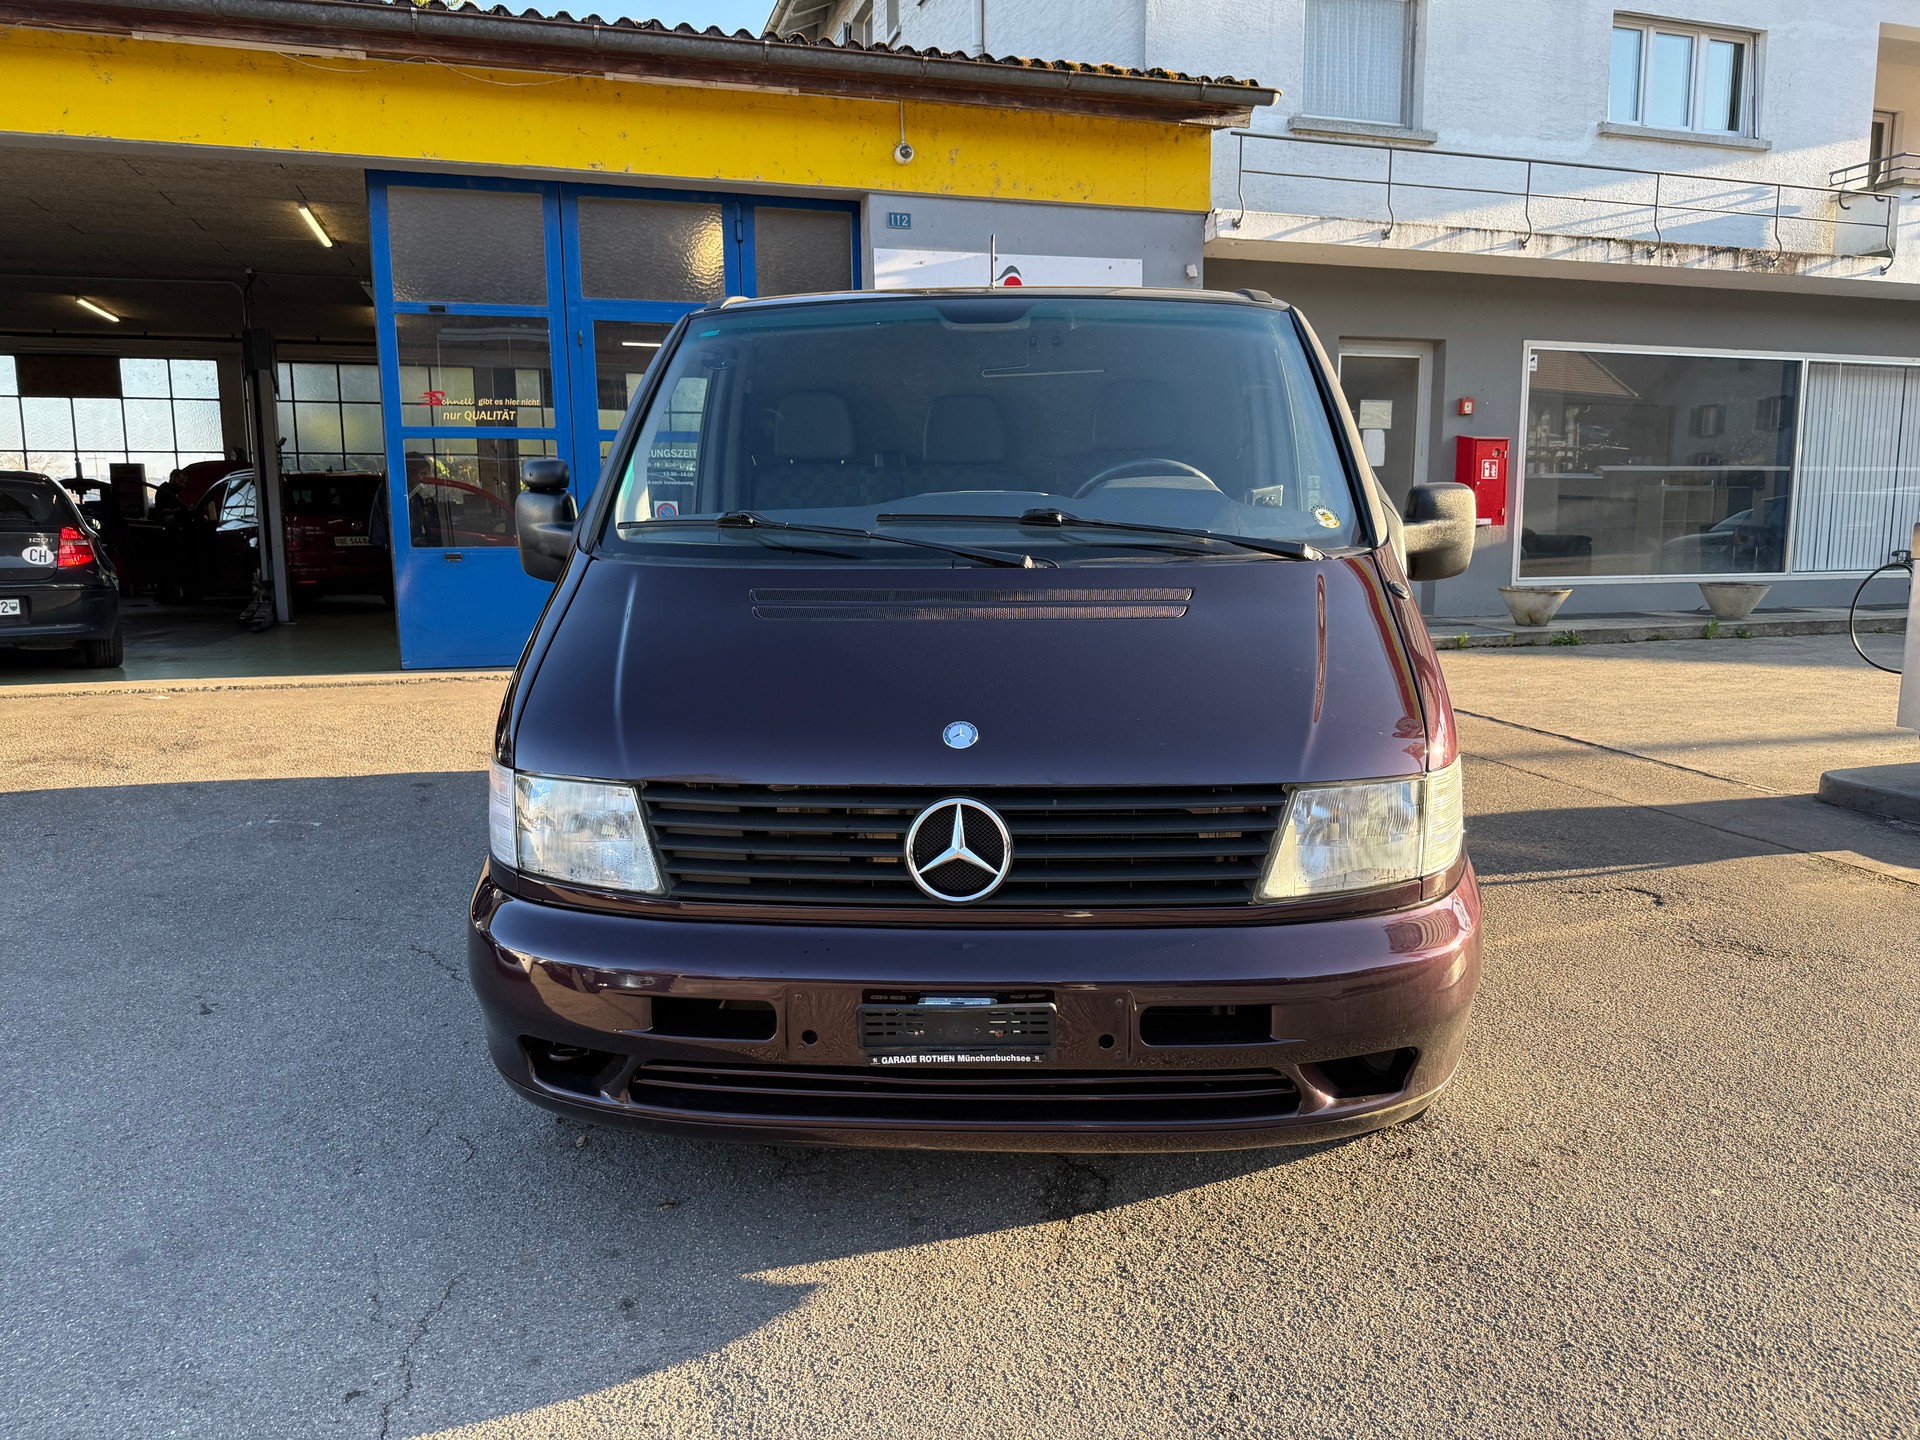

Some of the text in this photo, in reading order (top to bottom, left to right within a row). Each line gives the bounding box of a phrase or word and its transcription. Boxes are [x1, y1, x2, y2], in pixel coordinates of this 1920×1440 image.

[891, 214, 908, 226] 112
[417, 390, 474, 406] Schnell
[478, 398, 493, 406] gibt
[521, 398, 540, 406] nicht
[443, 409, 516, 421] nur QUALITÄT
[649, 449, 697, 458] UNGSZEIT
[30, 549, 47, 562] CH
[0, 601, 9, 613] 2
[881, 1054, 1031, 1064] GARAGE ROTHEN Münchenbuchsee
